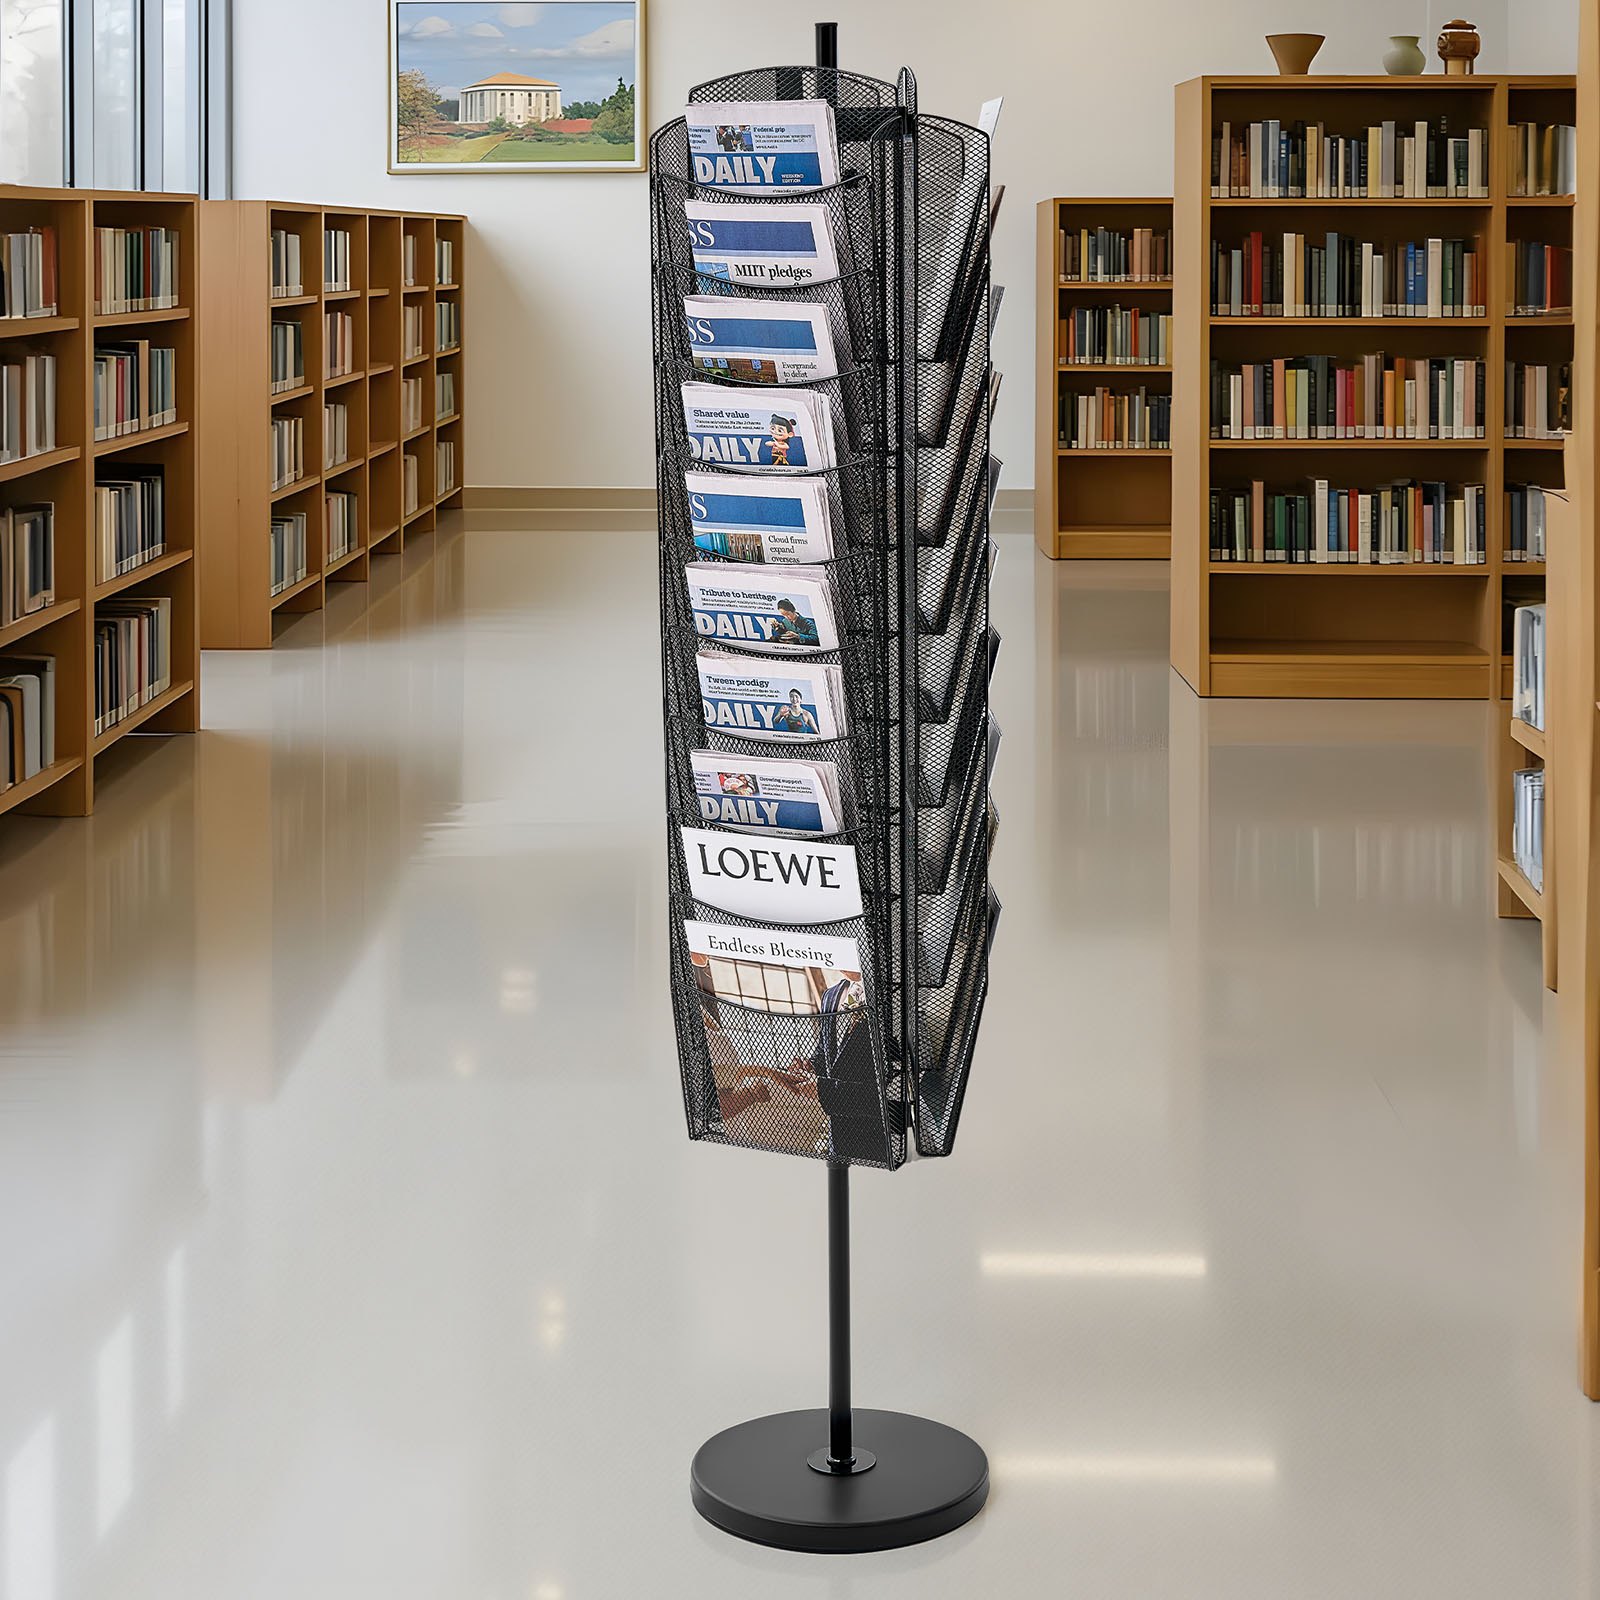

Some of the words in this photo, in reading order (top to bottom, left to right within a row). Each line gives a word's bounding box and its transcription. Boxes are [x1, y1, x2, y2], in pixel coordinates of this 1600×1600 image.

[694, 156, 776, 184] DAILY
[735, 265, 765, 278] MIIT
[768, 265, 812, 281] pledges
[782, 362, 817, 371] Evergrande
[790, 370, 808, 378] delist
[693, 409, 726, 418] Shared
[727, 411, 750, 419] value
[688, 435, 762, 463] DAILY
[768, 535, 788, 544] Cloud
[789, 536, 808, 545] firms
[769, 545, 795, 555] expand
[771, 554, 800, 562] overseas
[700, 588, 730, 598] Tribute
[731, 591, 741, 599] to
[742, 591, 777, 602] heritage
[694, 612, 777, 640] DAILY
[736, 679, 770, 688] prodigy
[703, 699, 776, 728] DAILY
[700, 796, 779, 826] DAILY
[697, 843, 841, 889] LOEWE
[708, 935, 765, 956] Endless
[769, 942, 833, 967] Blessing
